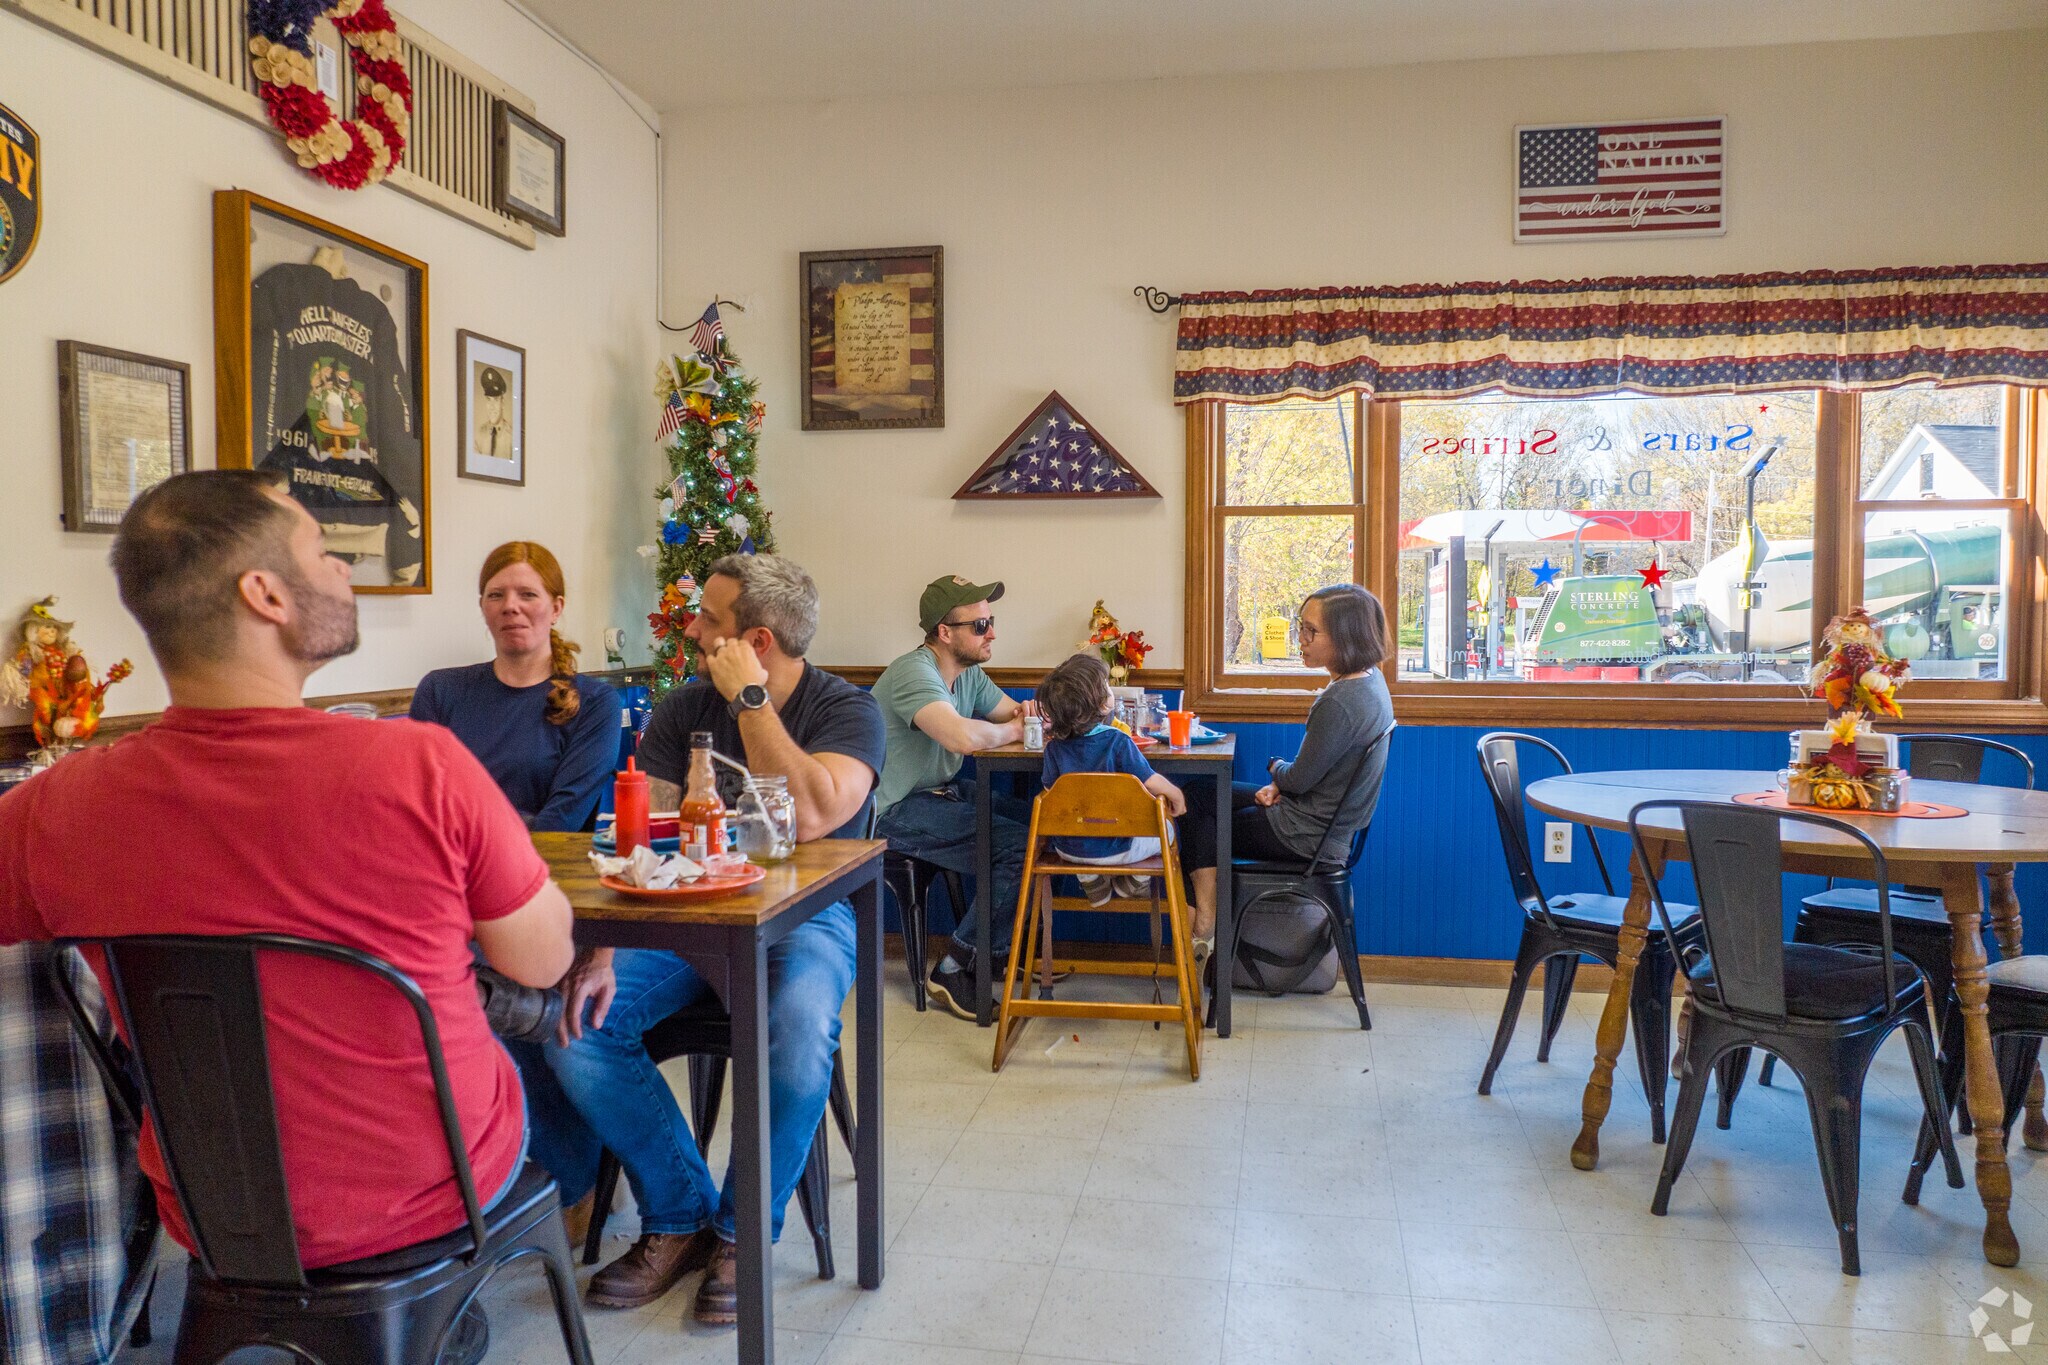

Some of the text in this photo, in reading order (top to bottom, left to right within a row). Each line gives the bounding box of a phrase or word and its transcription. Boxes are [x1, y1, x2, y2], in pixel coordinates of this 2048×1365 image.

[1604, 134, 1662, 151] ONE
[1604, 154, 1706, 171] NATION
[1544, 186, 1694, 228] under God
[1570, 591, 1639, 602] STERLING
[1571, 602, 1639, 610] CONCRETE
